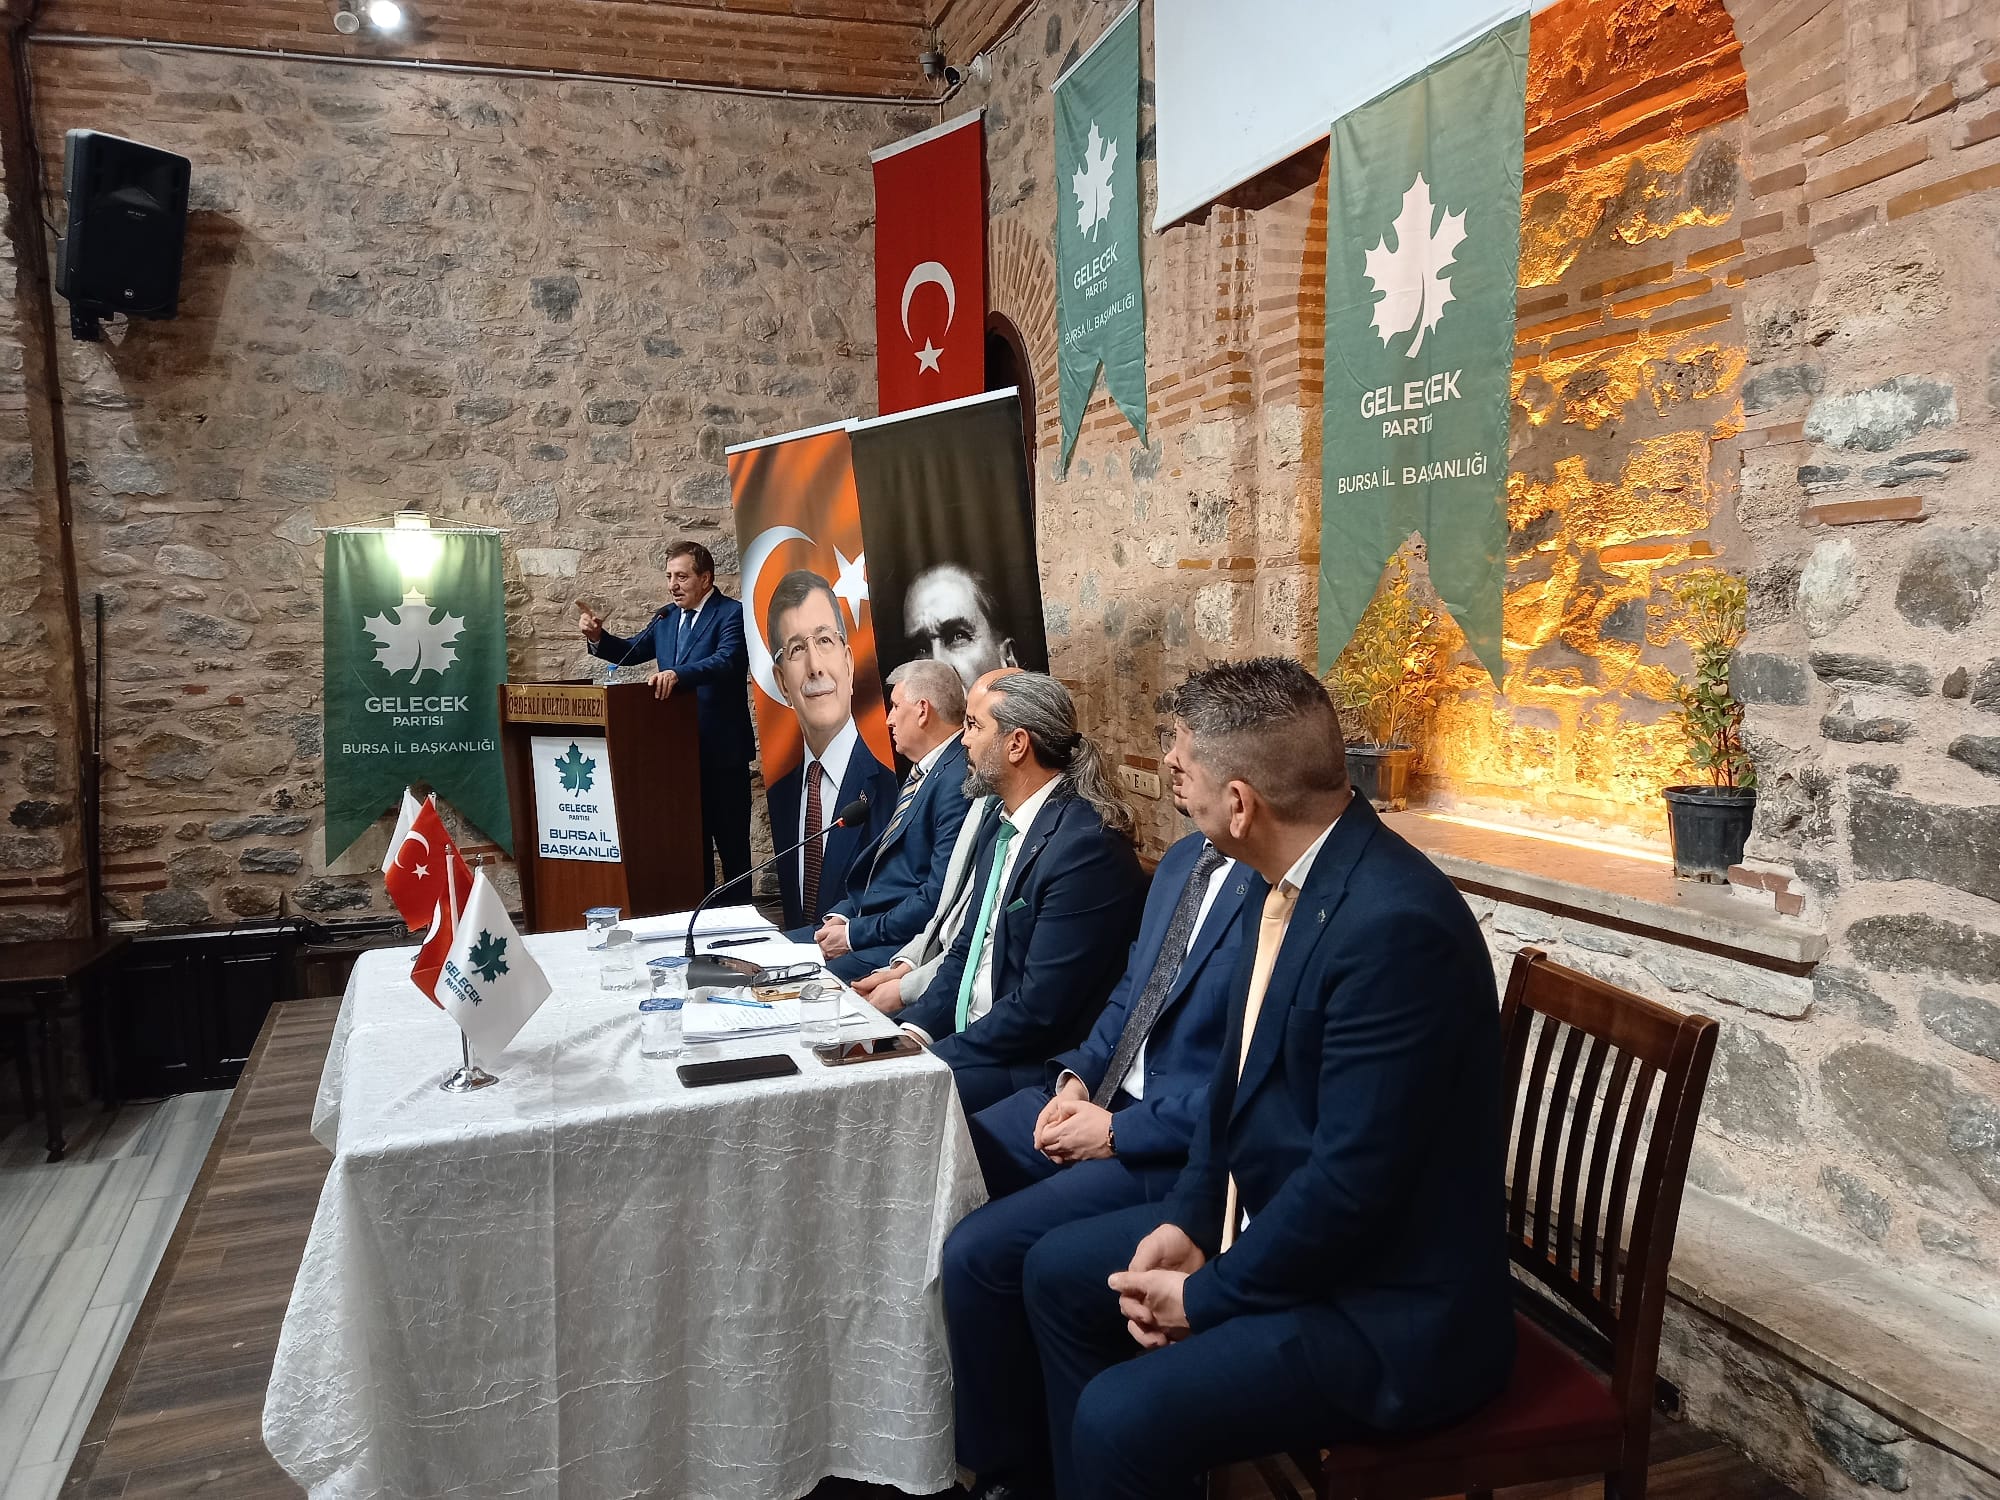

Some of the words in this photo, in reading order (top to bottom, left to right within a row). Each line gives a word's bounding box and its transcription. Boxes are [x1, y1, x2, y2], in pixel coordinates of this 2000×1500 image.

[1073, 241, 1118, 290] GELECEK
[1338, 471, 1380, 495] BURSA
[1382, 465, 1396, 487] İL
[364, 695, 470, 713] GELECEK
[508, 691, 540, 715] ÖRDEKLİ
[541, 692, 570, 716] KÜLTÜR
[571, 694, 604, 718] MERKEZİ
[342, 743, 390, 754] BURSA
[394, 741, 407, 754] İL
[410, 738, 495, 755] BAŞKANLIĞI
[558, 803, 599, 814] GELECEK
[549, 828, 598, 842] BURSA
[599, 829, 612, 843] İL
[445, 960, 483, 1008] GELECEK
